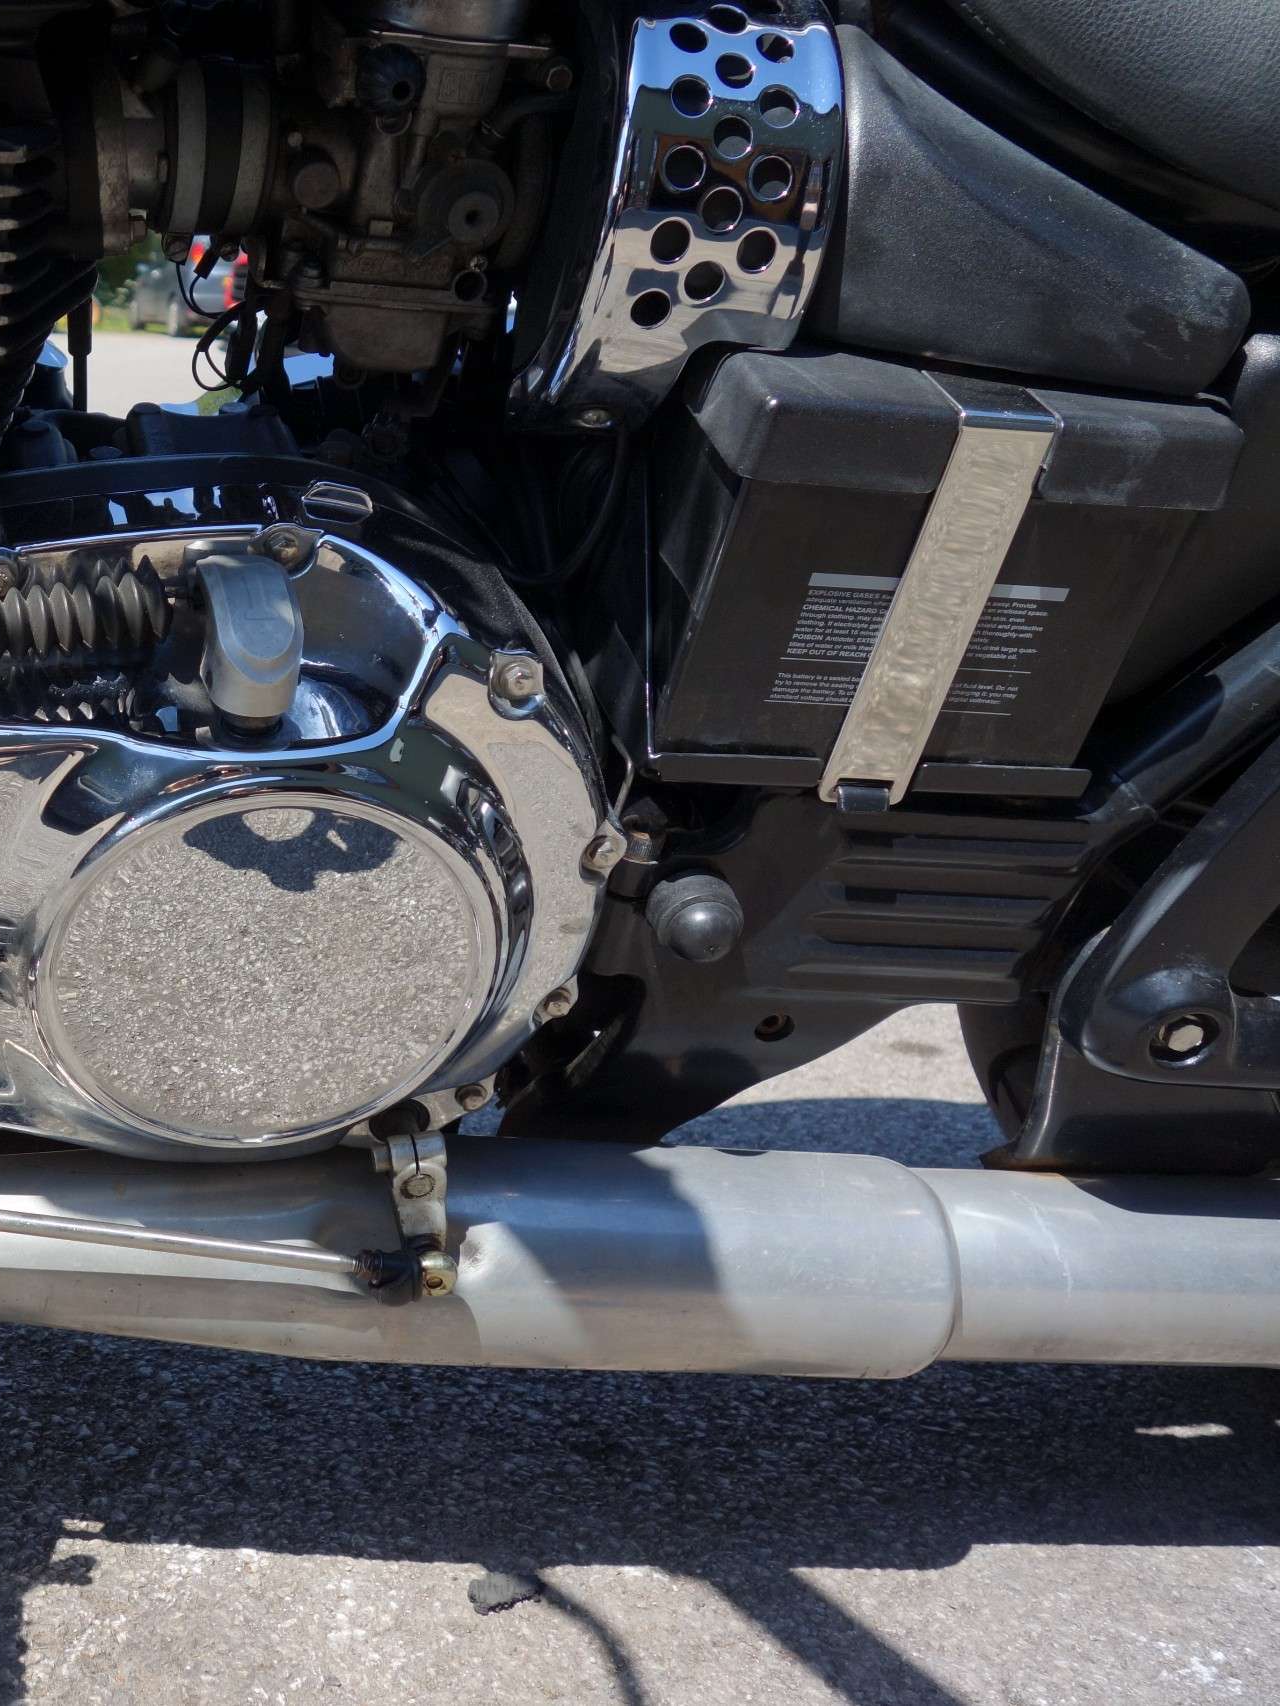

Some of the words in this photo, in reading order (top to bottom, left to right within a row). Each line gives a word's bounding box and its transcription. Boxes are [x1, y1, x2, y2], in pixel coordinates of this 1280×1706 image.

[803, 603, 842, 612] CHEMICAL
[845, 606, 876, 614] HAZARD
[838, 650, 866, 658] REACH
